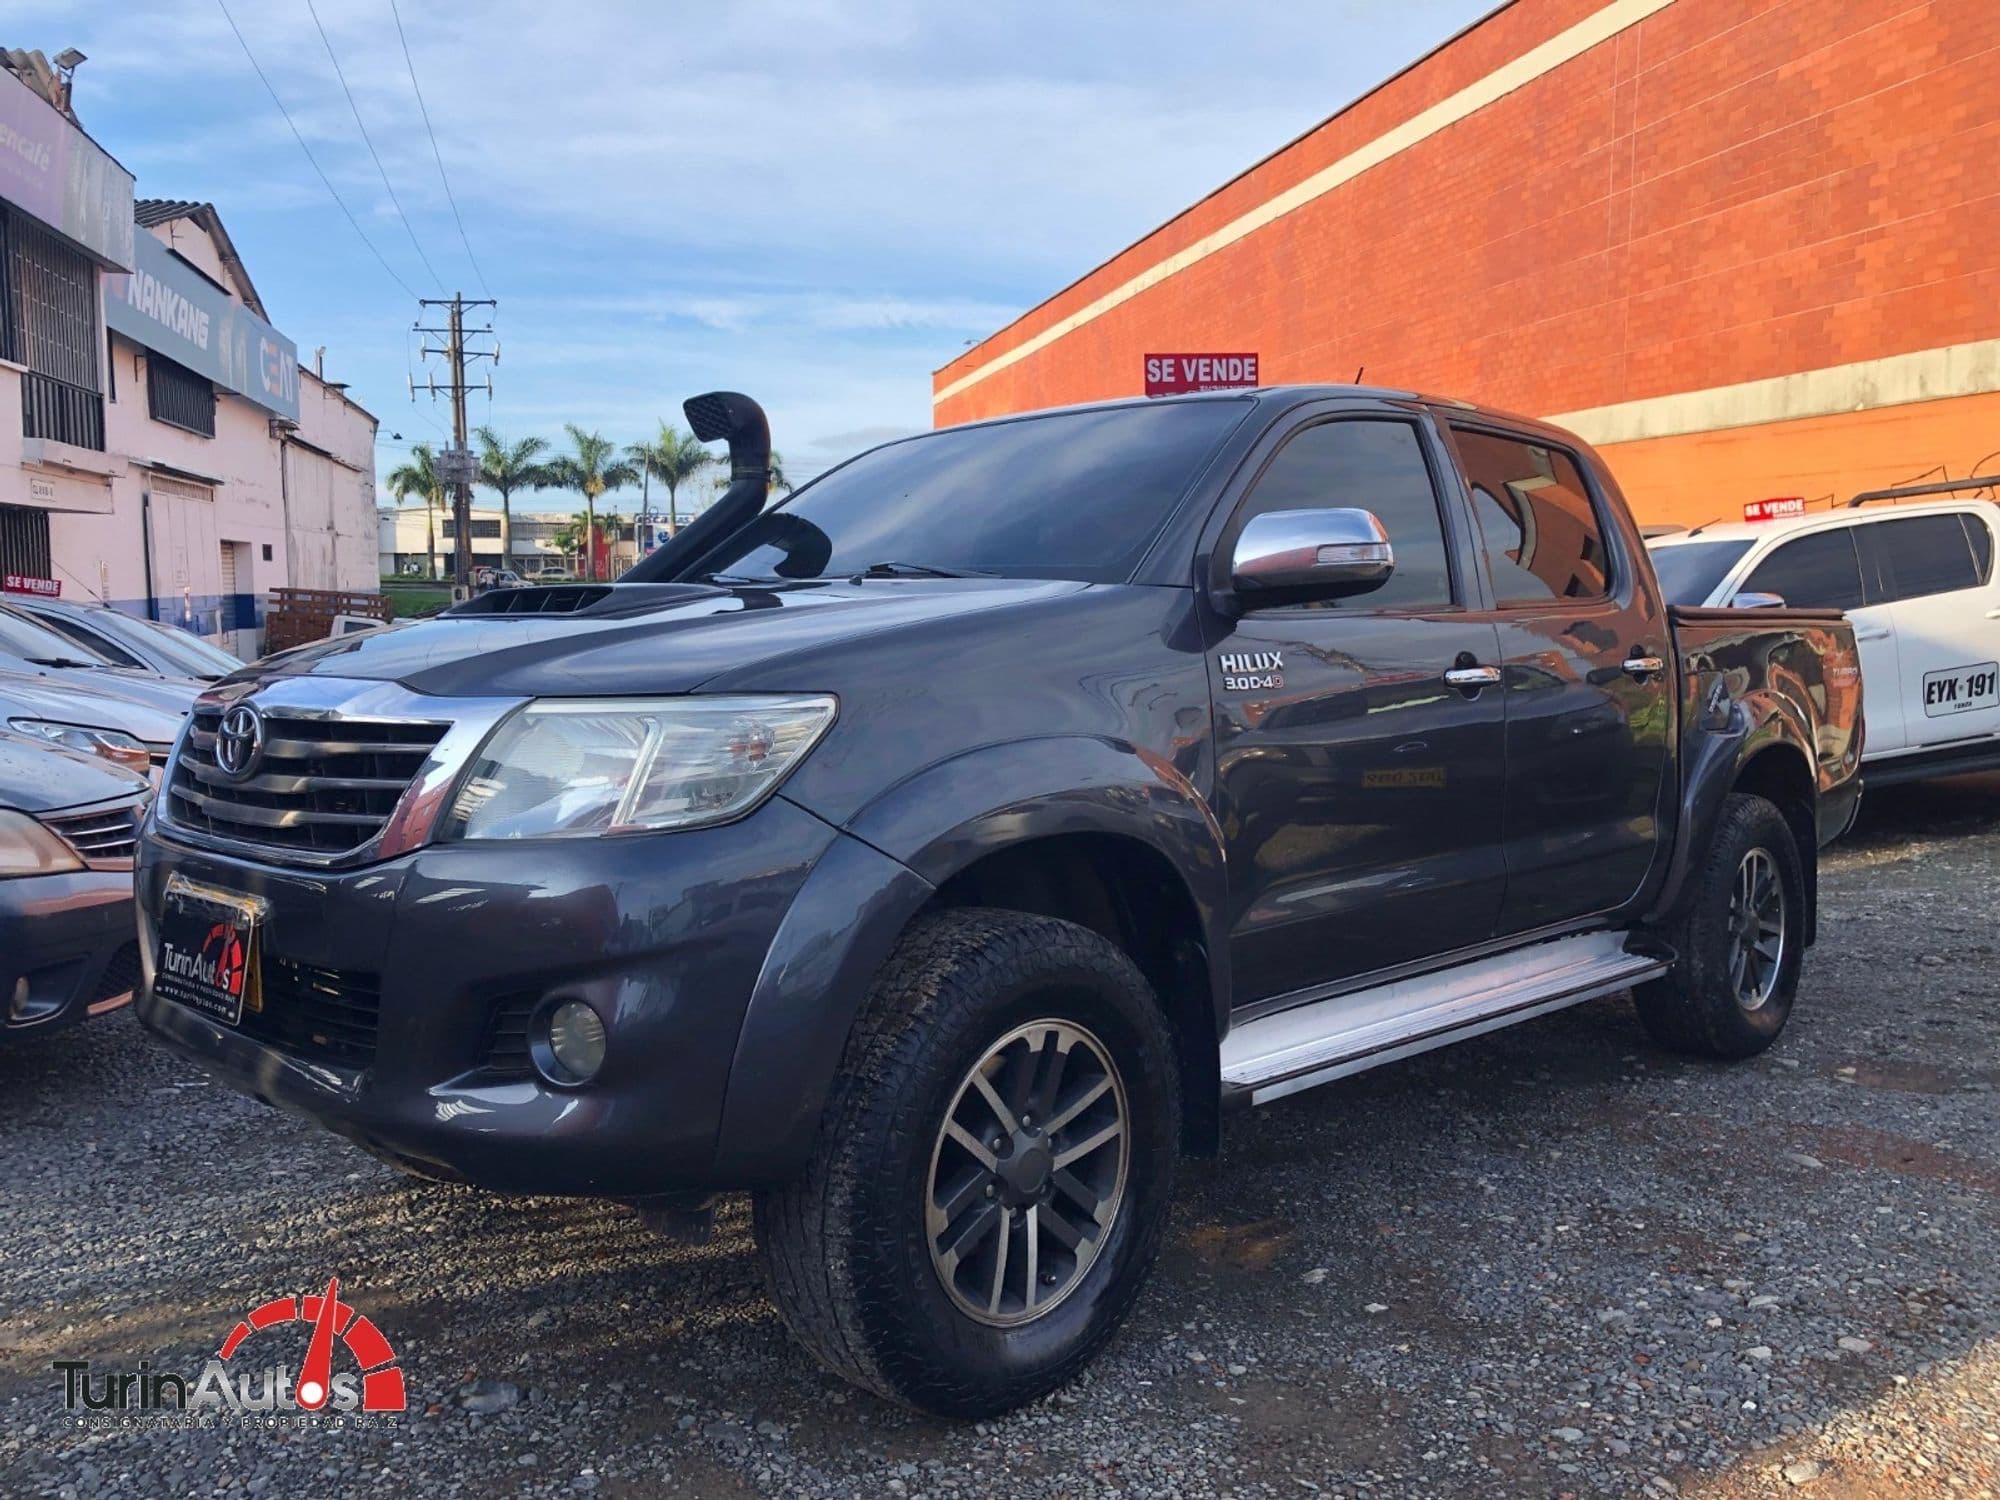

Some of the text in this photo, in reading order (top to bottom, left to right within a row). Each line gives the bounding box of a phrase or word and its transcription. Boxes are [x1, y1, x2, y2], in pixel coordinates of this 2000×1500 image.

[127, 268, 210, 351] NANKANG
[1147, 357, 1257, 383] SE VENDE
[1745, 505, 1761, 517] SE
[1762, 499, 1804, 514] VENDE
[7, 575, 21, 588] SE
[23, 577, 60, 592] VENDE
[1219, 651, 1284, 673] HILUX
[1926, 671, 1996, 705] EYX 191
